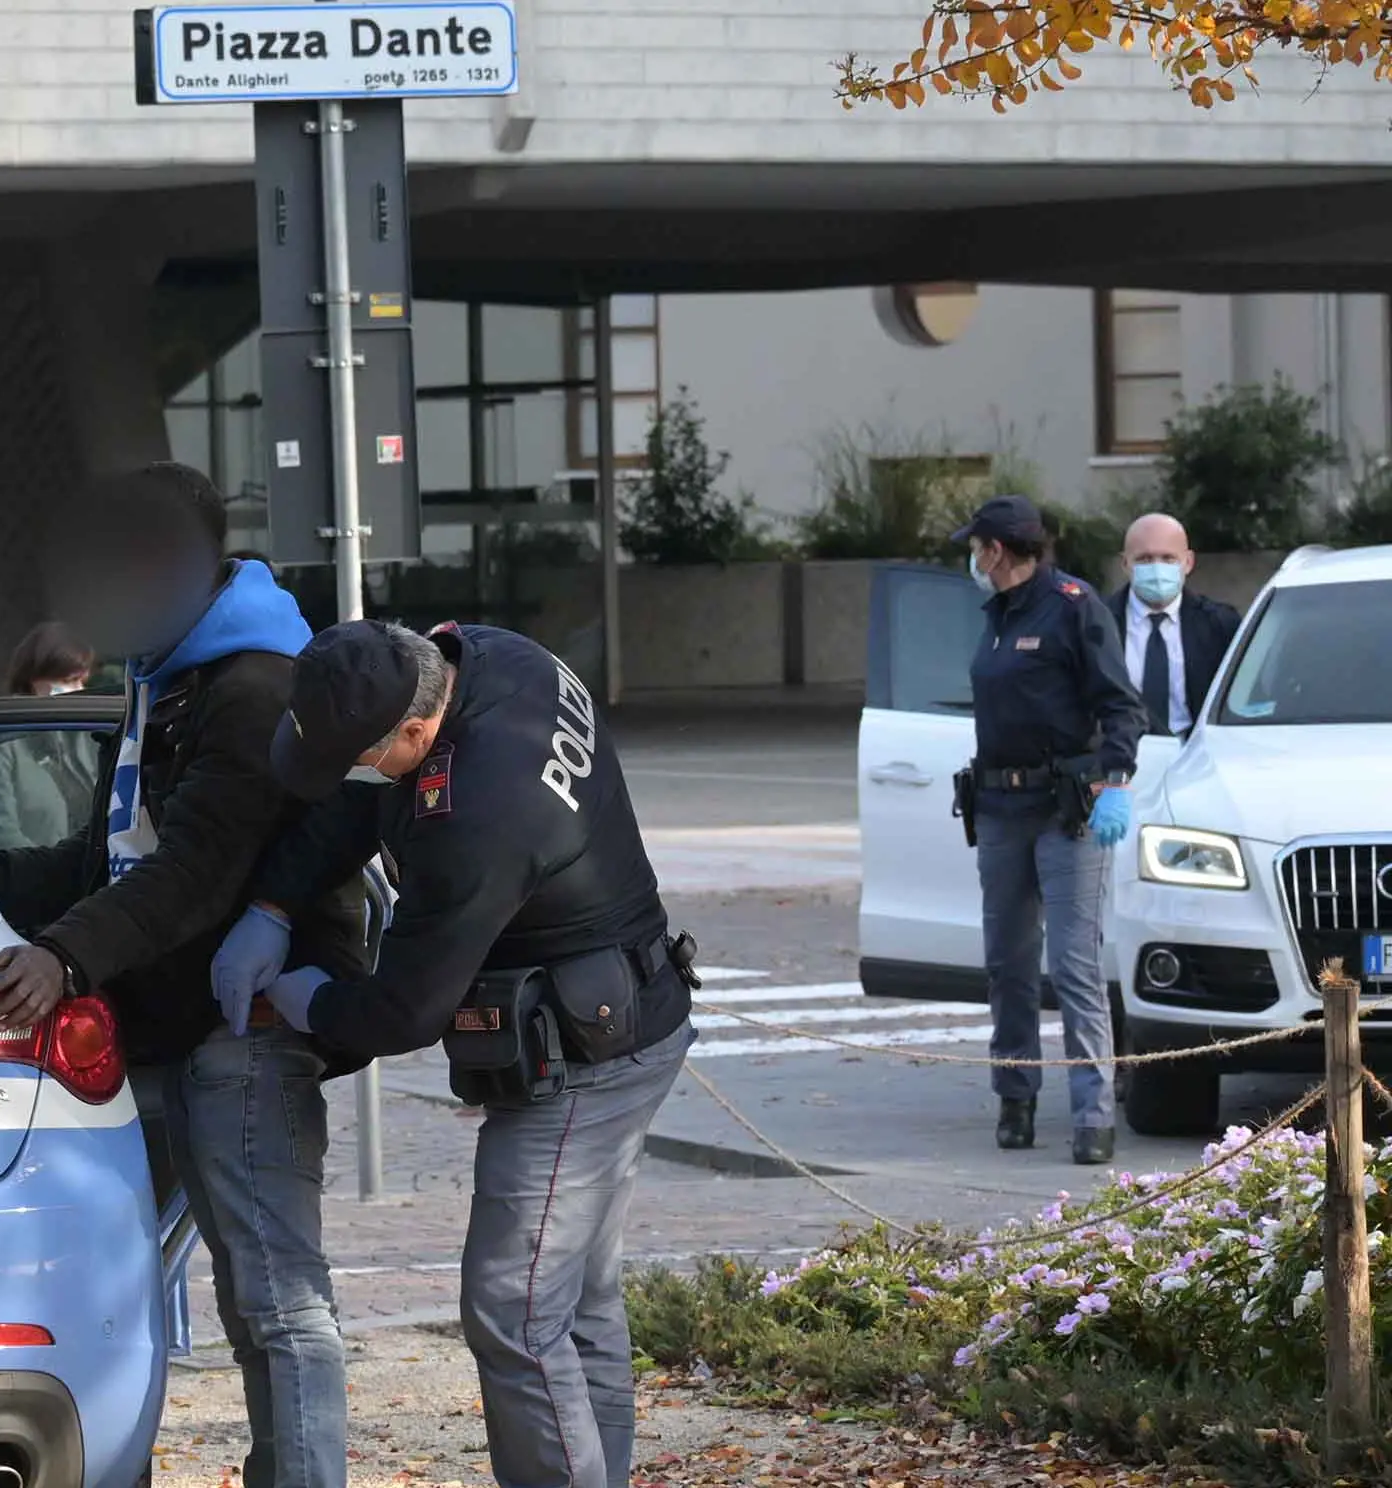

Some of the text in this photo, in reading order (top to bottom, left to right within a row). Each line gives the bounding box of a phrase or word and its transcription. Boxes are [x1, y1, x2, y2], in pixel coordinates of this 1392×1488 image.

[181, 16, 492, 61] Piazza Dante
[175, 74, 219, 88] Dante
[226, 73, 289, 89] Alighieri
[363, 70, 406, 88] poeta
[412, 69, 449, 83] 1265
[466, 67, 500, 81] 1321
[540, 654, 596, 812] POLIZI
[458, 1011, 496, 1027] POLIA
